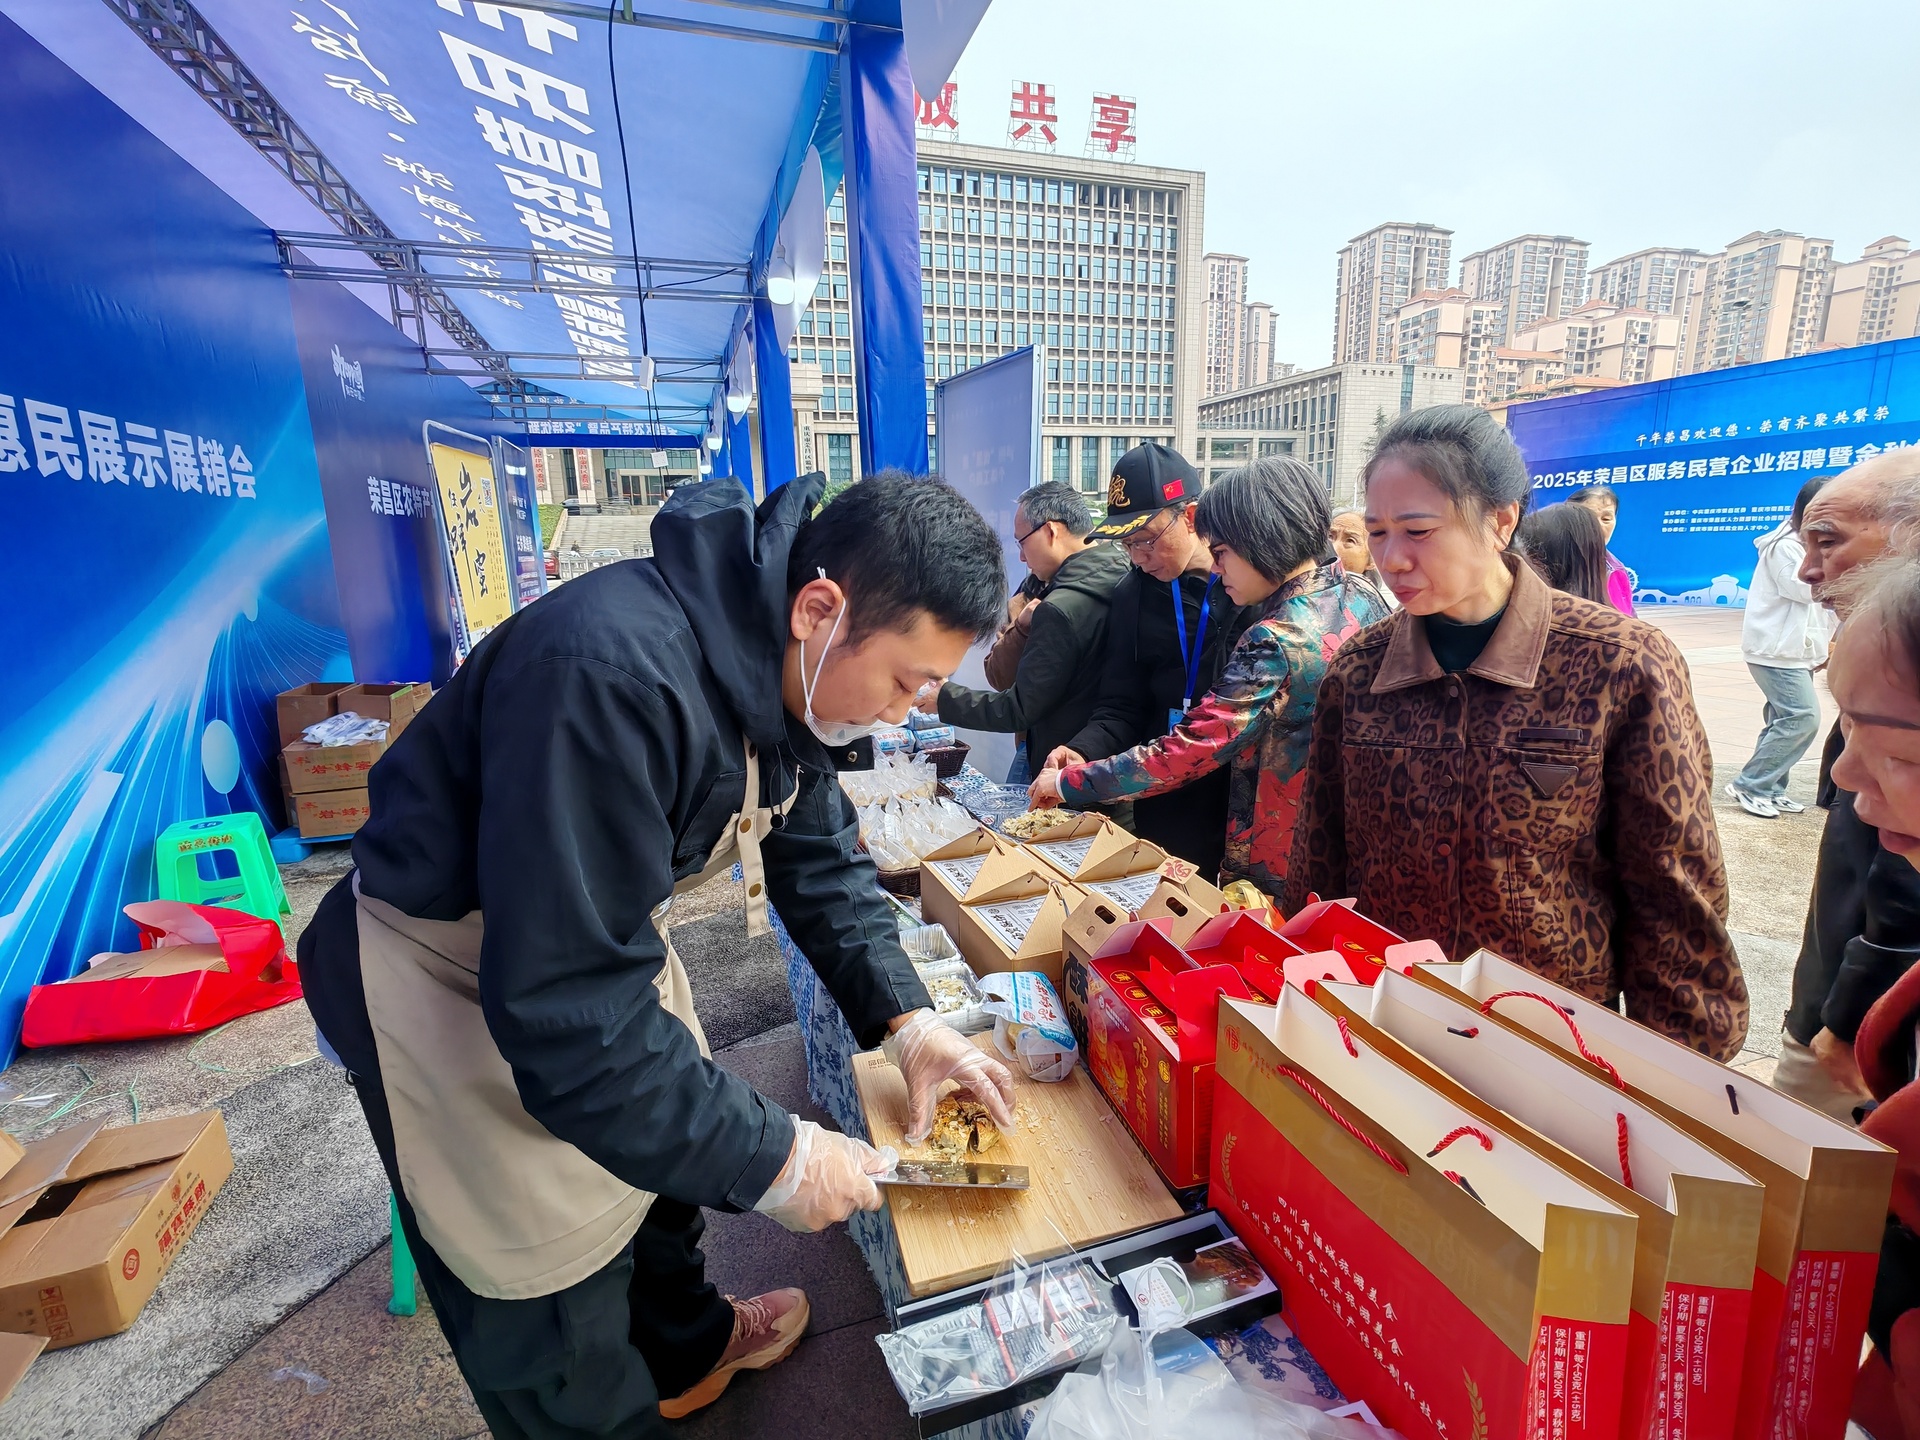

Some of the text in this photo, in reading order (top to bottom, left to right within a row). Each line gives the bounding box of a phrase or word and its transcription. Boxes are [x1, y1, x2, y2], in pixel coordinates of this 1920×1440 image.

[803, 425, 812, 474] 重庆市荣昌区监察
[1533, 438, 1920, 489] 2025年荣昌区服务民营企业招聘暨金
[367, 475, 435, 519] 荣昌区农特产
